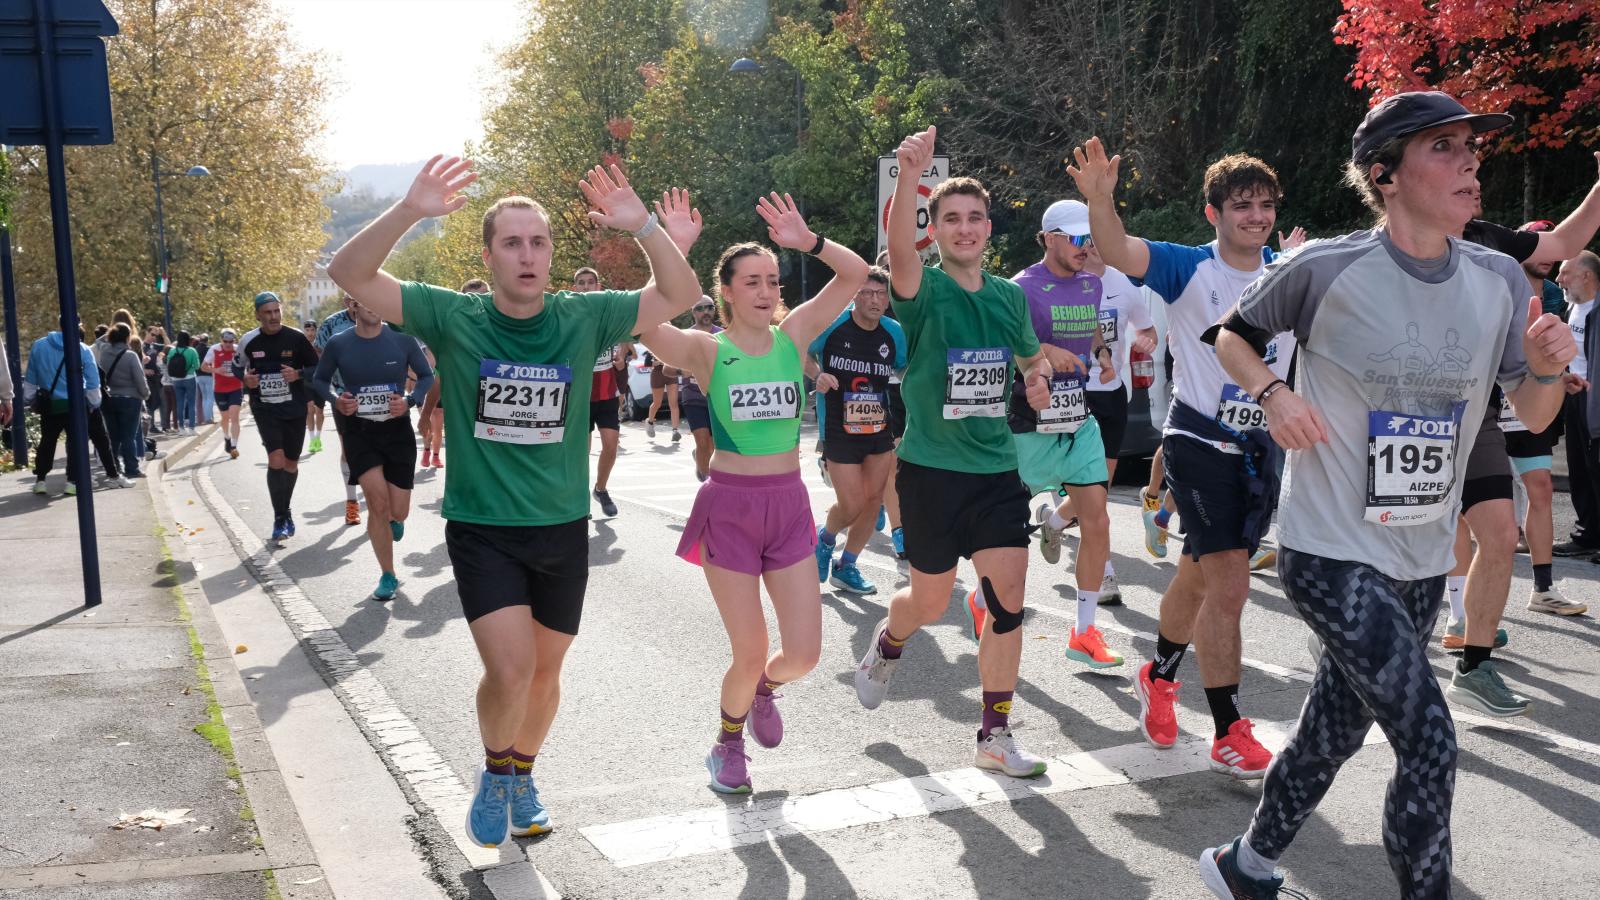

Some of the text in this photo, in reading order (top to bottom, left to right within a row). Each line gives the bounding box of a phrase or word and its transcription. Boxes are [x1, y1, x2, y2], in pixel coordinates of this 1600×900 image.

[1051, 304, 1096, 320] BEHOBIA
[1053, 322, 1067, 331] SAN
[830, 355, 871, 374] MOGODA
[954, 367, 1005, 386] 22309
[1363, 369, 1479, 389] San Silvestre
[486, 384, 561, 407] 22311
[731, 386, 795, 407] 22310
[510, 410, 538, 419] JORGE
[752, 410, 781, 418] LORENA
[1409, 482, 1446, 492] AIZPE
